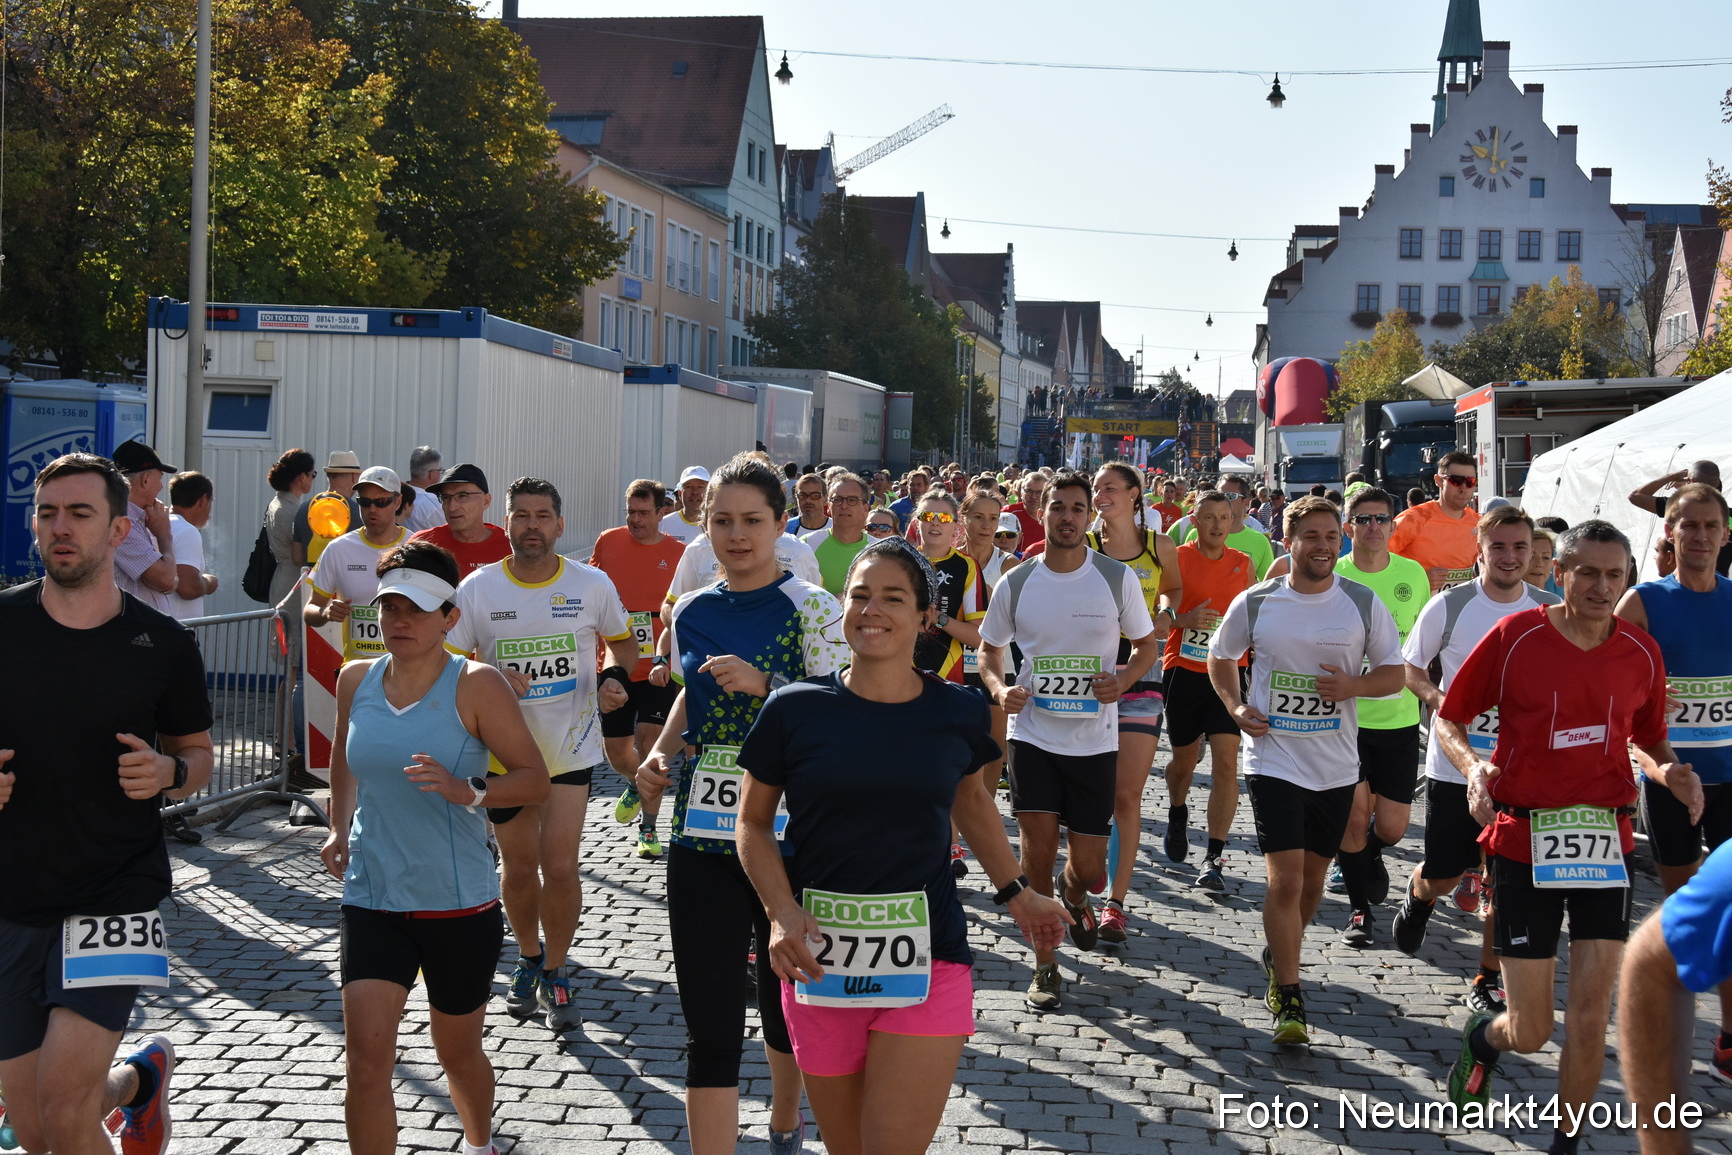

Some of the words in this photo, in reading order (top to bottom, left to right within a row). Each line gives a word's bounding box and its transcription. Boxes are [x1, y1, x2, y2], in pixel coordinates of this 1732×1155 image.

[316, 315, 334, 323] 08141
[338, 316, 350, 324] 536
[350, 316, 358, 324] 80
[32, 406, 55, 416] 08141
[62, 408, 76, 417] 536
[78, 409, 88, 418] 80
[1102, 422, 1140, 432] START
[1446, 570, 1469, 580] OCK
[551, 595, 566, 605] 20
[357, 623, 381, 638] 10
[1188, 629, 1212, 646] 22
[502, 636, 571, 657] BOCK
[1038, 657, 1096, 672] BOCK
[1038, 677, 1092, 696] 2227
[1048, 701, 1083, 710] JONAS
[1277, 694, 1336, 715] 2229
[1274, 719, 1334, 730] CHRISTIAN
[1568, 731, 1591, 742] DEHN
[702, 749, 741, 771] BO
[700, 777, 741, 807] 26
[717, 816, 736, 829] NI
[1539, 808, 1615, 829] BOCK
[1543, 833, 1611, 860] 2577
[1554, 866, 1608, 878] MARTIN
[811, 895, 919, 925] BOCK
[79, 915, 163, 950] 2836
[815, 933, 916, 968] 2770
[844, 976, 883, 995] Ulla
